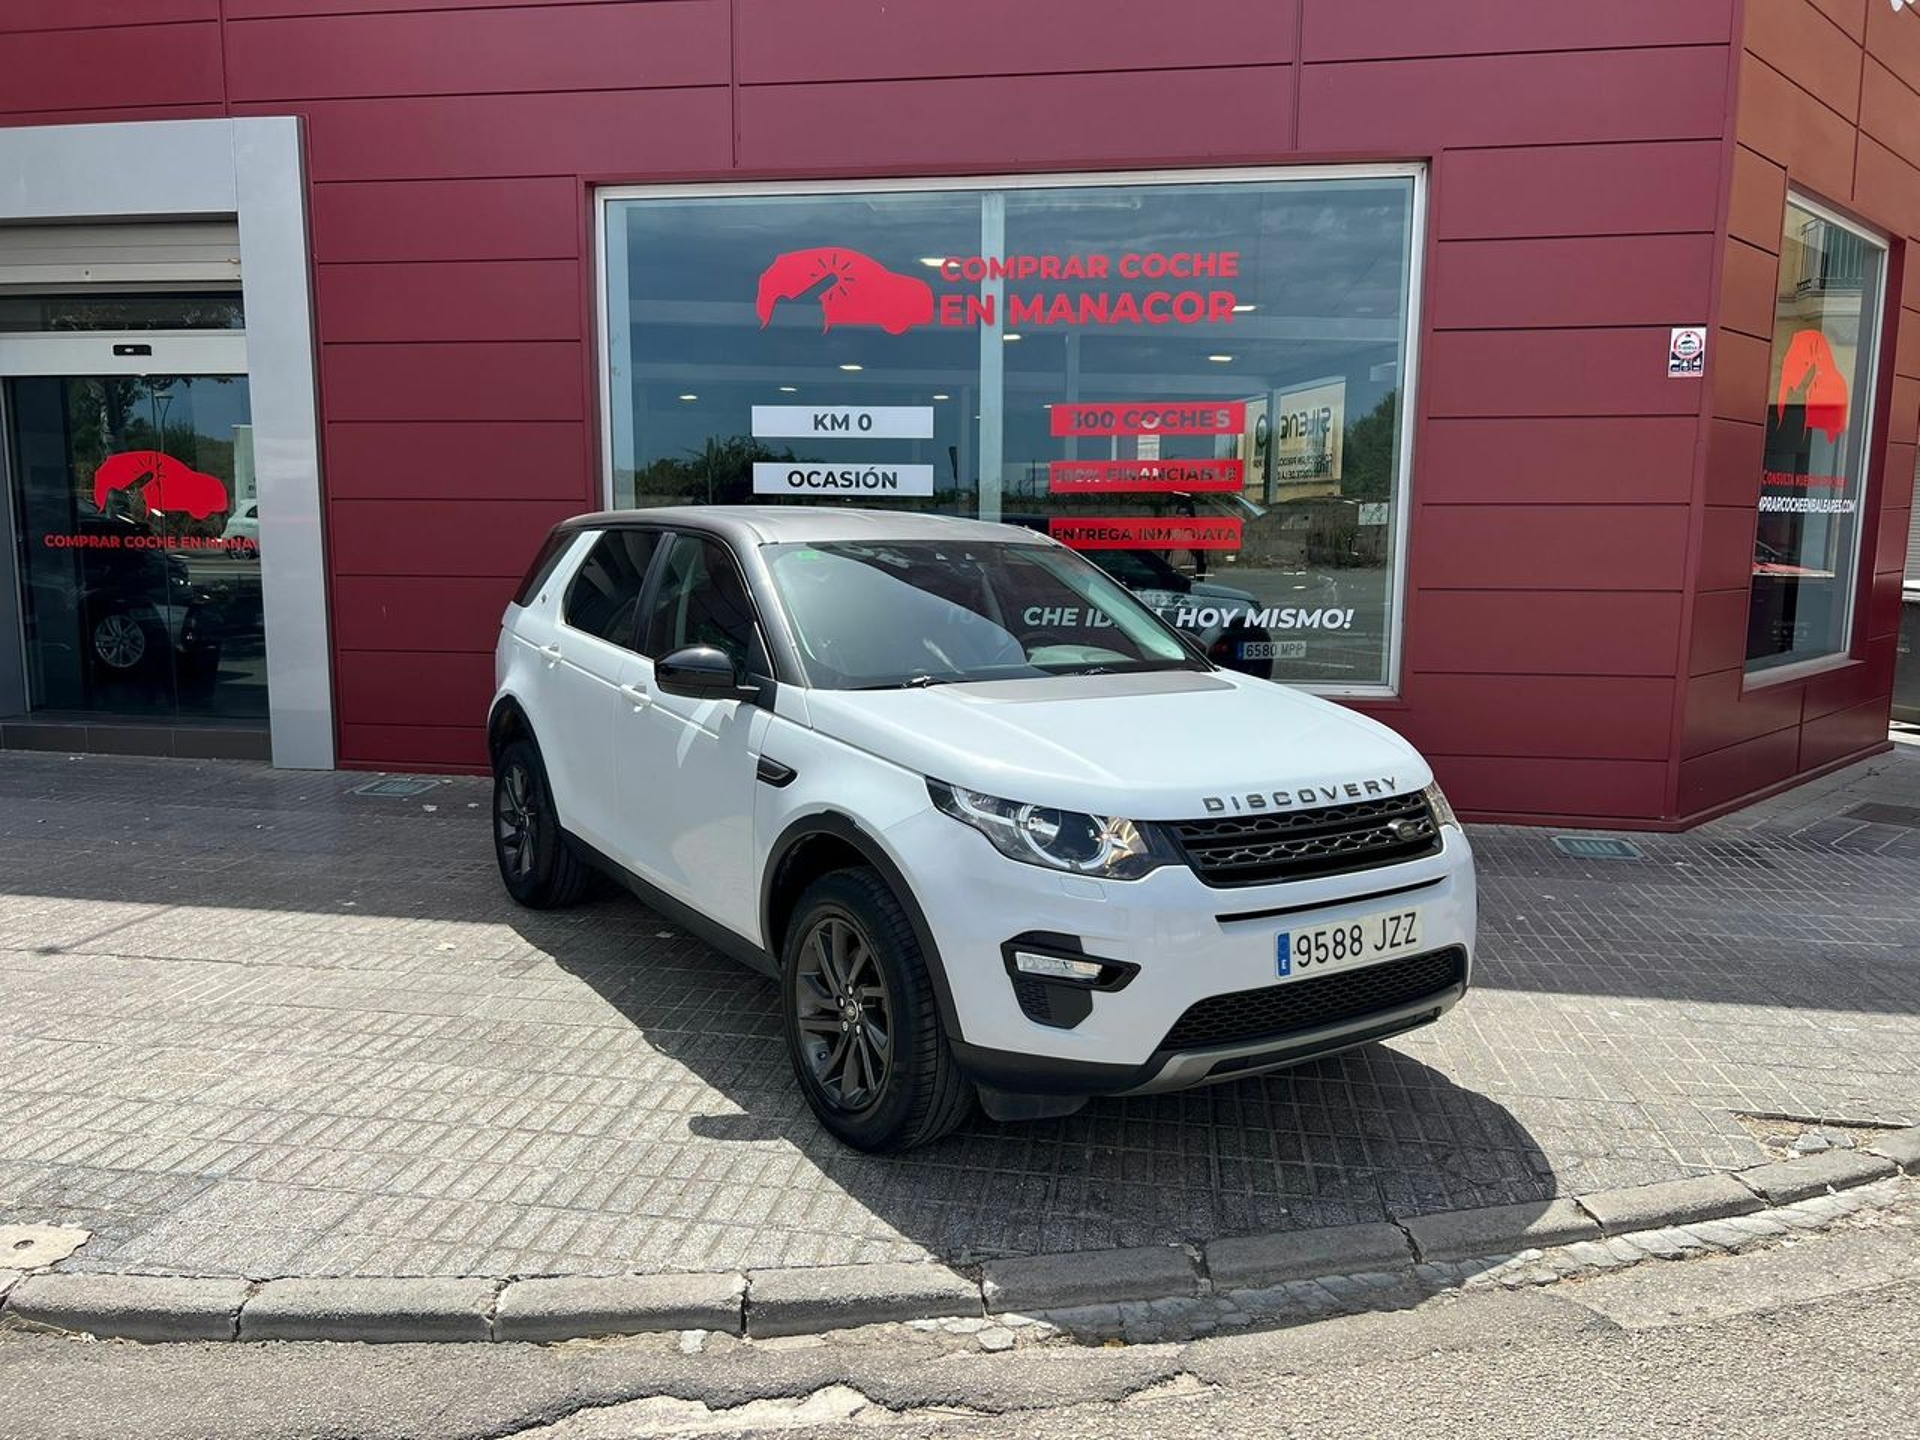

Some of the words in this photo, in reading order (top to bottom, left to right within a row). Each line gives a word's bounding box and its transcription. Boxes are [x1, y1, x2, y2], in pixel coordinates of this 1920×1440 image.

[940, 254, 1109, 282] COMPRAR
[1119, 251, 1240, 279] COCHE
[939, 293, 996, 327] EN
[1009, 290, 1237, 326] MANACOR
[813, 413, 850, 431] KM
[857, 413, 873, 432] 0
[1069, 409, 1117, 430] 300
[1123, 408, 1231, 430] COCHES
[787, 466, 898, 490] OCASIÓN
[1107, 466, 1238, 482] FINANCIABLE
[44, 534, 121, 549] COMPRAR
[124, 536, 177, 550] COCHE
[181, 536, 203, 550] EN
[206, 536, 258, 551] MANA
[1053, 526, 1133, 542] ENTREGA
[1138, 527, 1238, 542] INMEDIATA
[1175, 608, 1239, 629] HOY
[1244, 608, 1354, 630] MISMO!
[1246, 644, 1277, 658] 6580
[1203, 777, 1397, 811] DISCOVERY
[1296, 924, 1363, 968] 9588
[1374, 911, 1417, 951] JZZ
